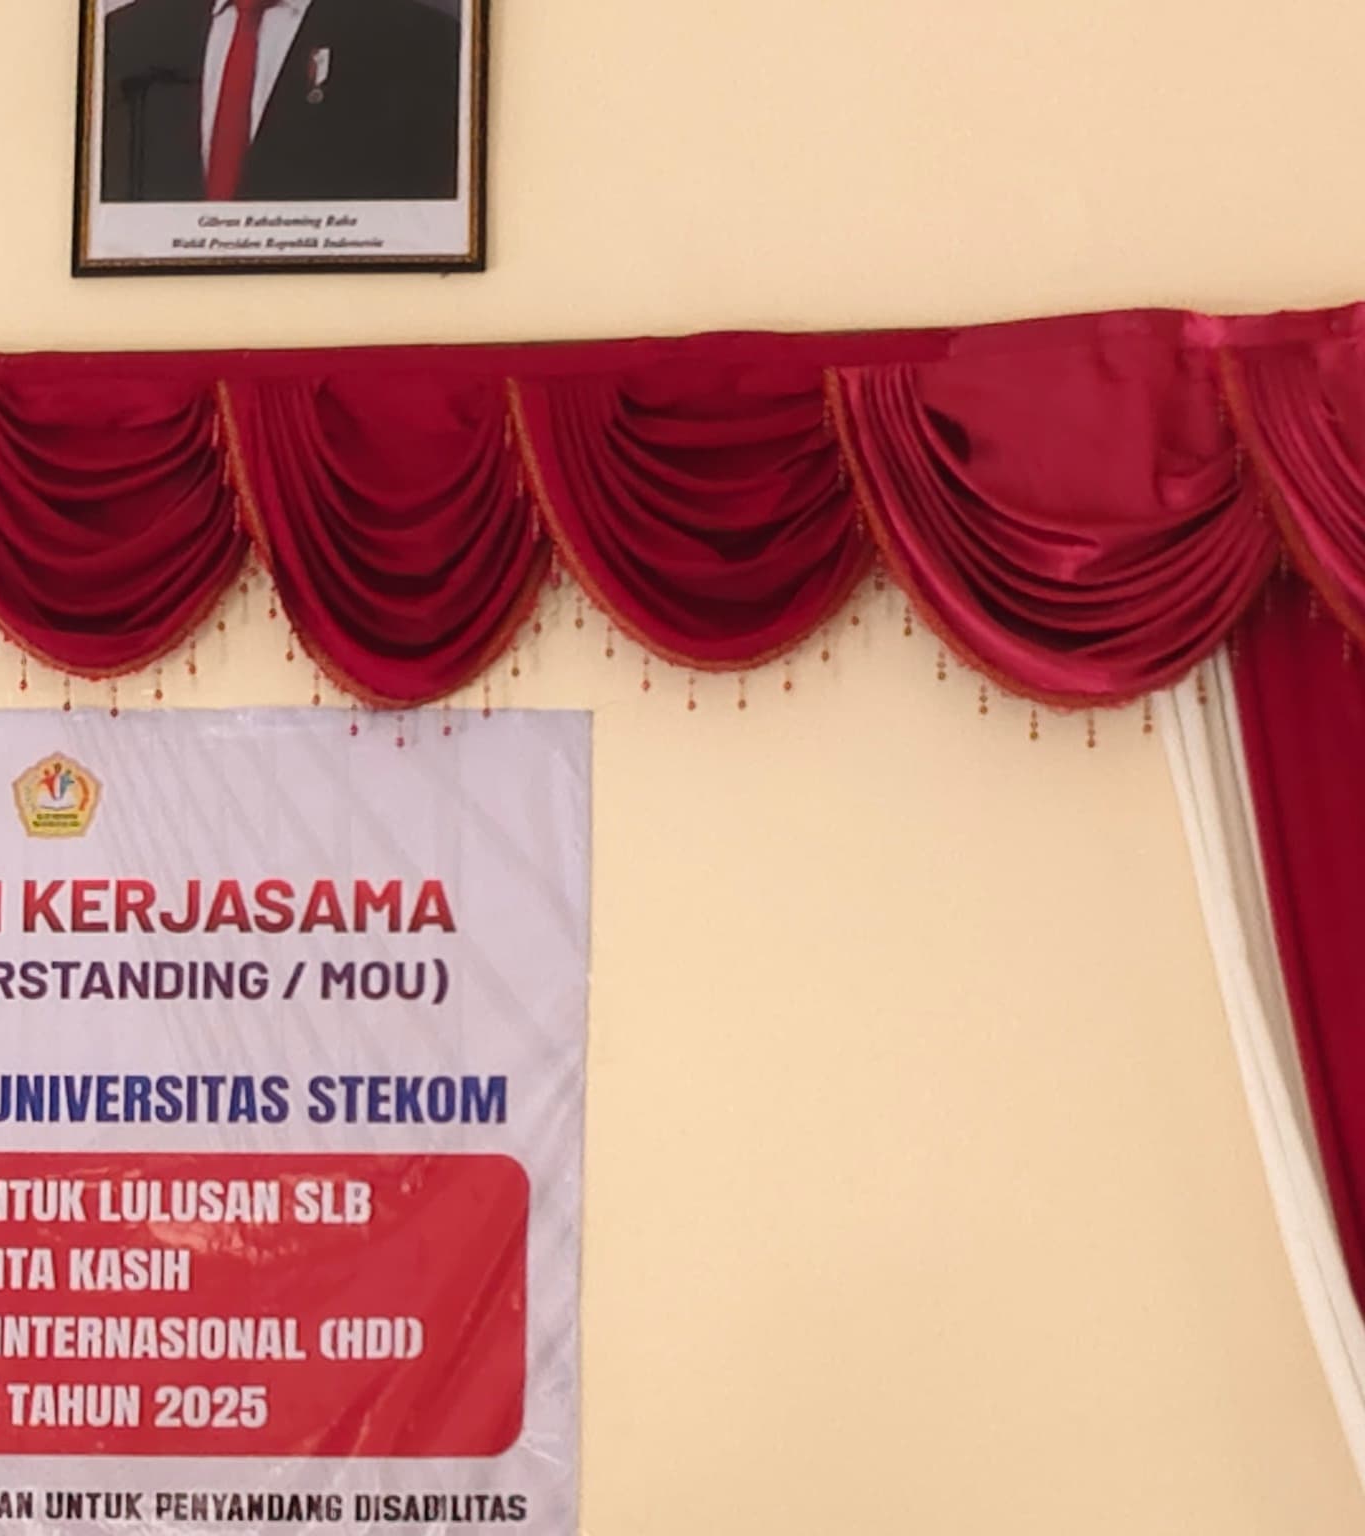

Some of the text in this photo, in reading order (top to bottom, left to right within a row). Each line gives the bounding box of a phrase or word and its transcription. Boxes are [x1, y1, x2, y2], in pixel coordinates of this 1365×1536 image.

[22, 879, 457, 933] KERJASAMA
[282, 961, 306, 999] /
[321, 959, 450, 1005] MOU)
[308, 1075, 509, 1124] STEKOM
[99, 1181, 280, 1223] LULUSAN
[294, 1182, 371, 1224] SLB
[69, 1248, 190, 1291] KASIH
[319, 1317, 424, 1360] (HDI)
[7, 1384, 141, 1426] TAHUN
[154, 1385, 268, 1428] 2025
[45, 1491, 144, 1520] UNTUK
[156, 1492, 343, 1521] PENYANDANG
[354, 1493, 528, 1522] DISABILITAS
